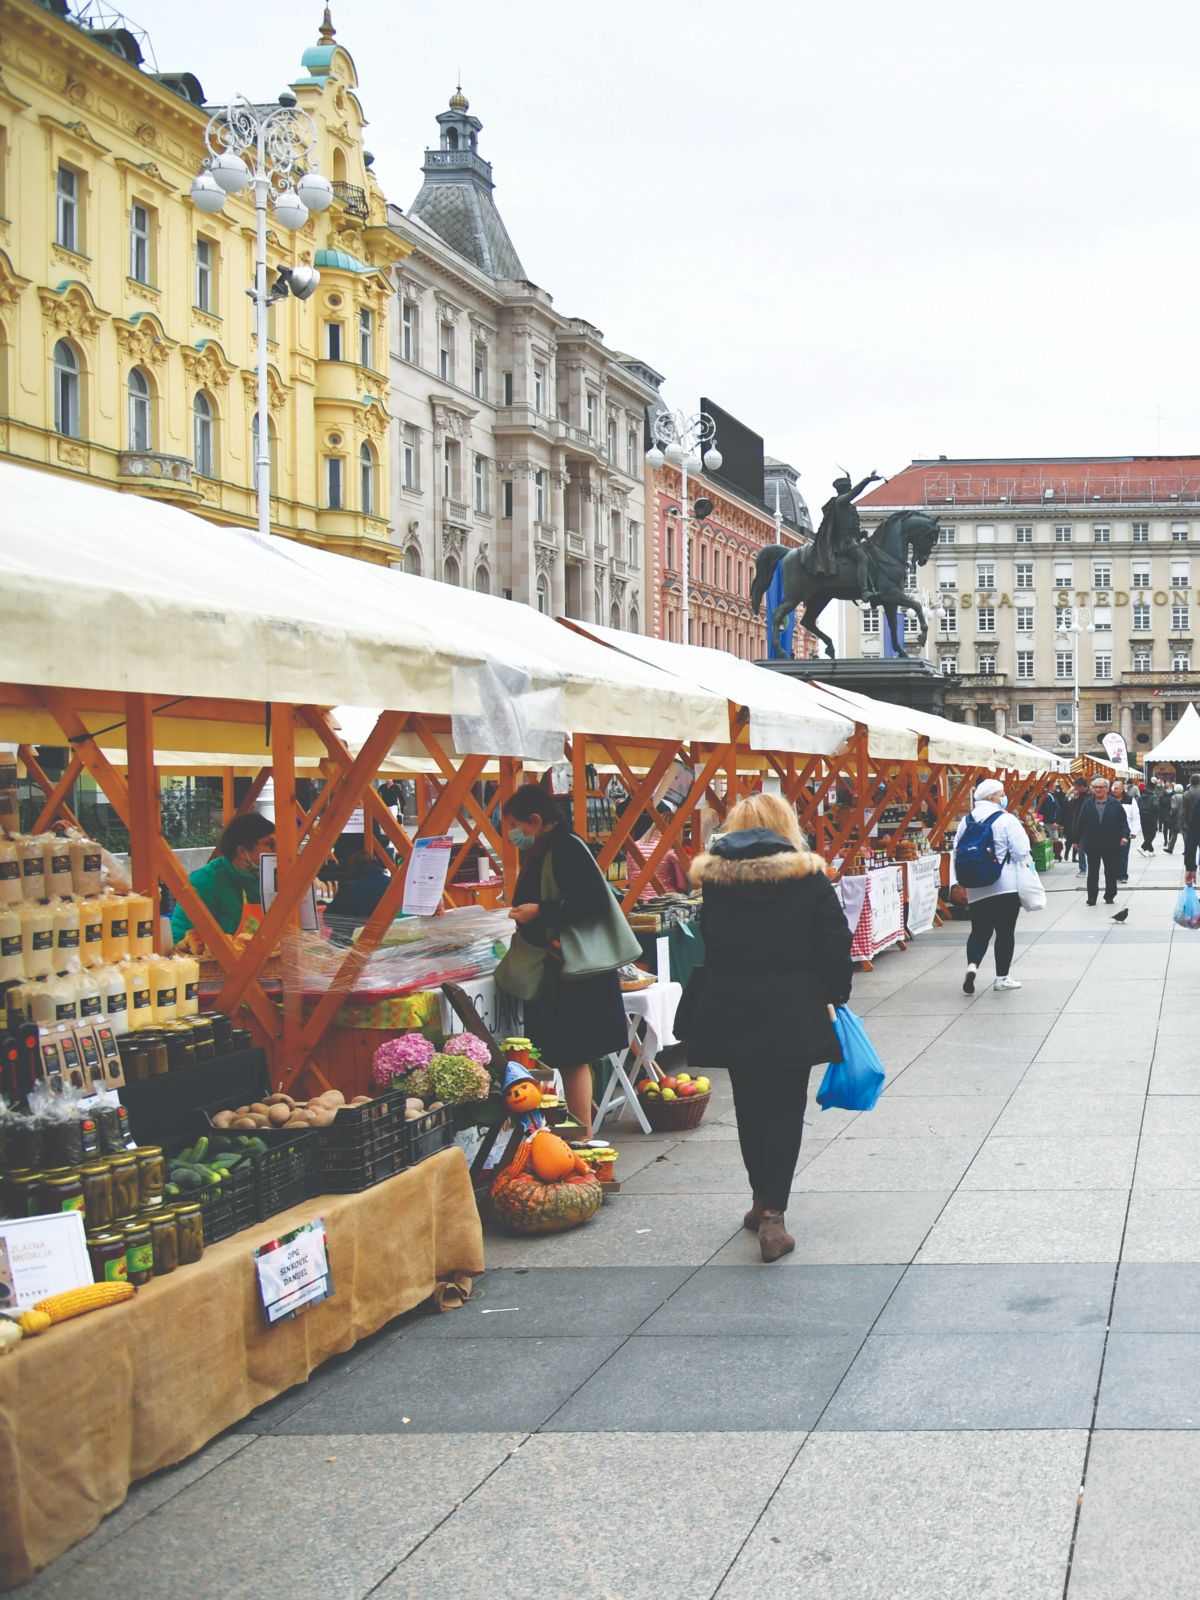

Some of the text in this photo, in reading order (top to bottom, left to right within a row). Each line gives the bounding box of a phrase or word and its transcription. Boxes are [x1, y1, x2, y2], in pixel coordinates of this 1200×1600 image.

[11, 1240, 47, 1254] ZLATNA
[12, 1249, 53, 1262] MEDALJA
[287, 1248, 300, 1260] OPG
